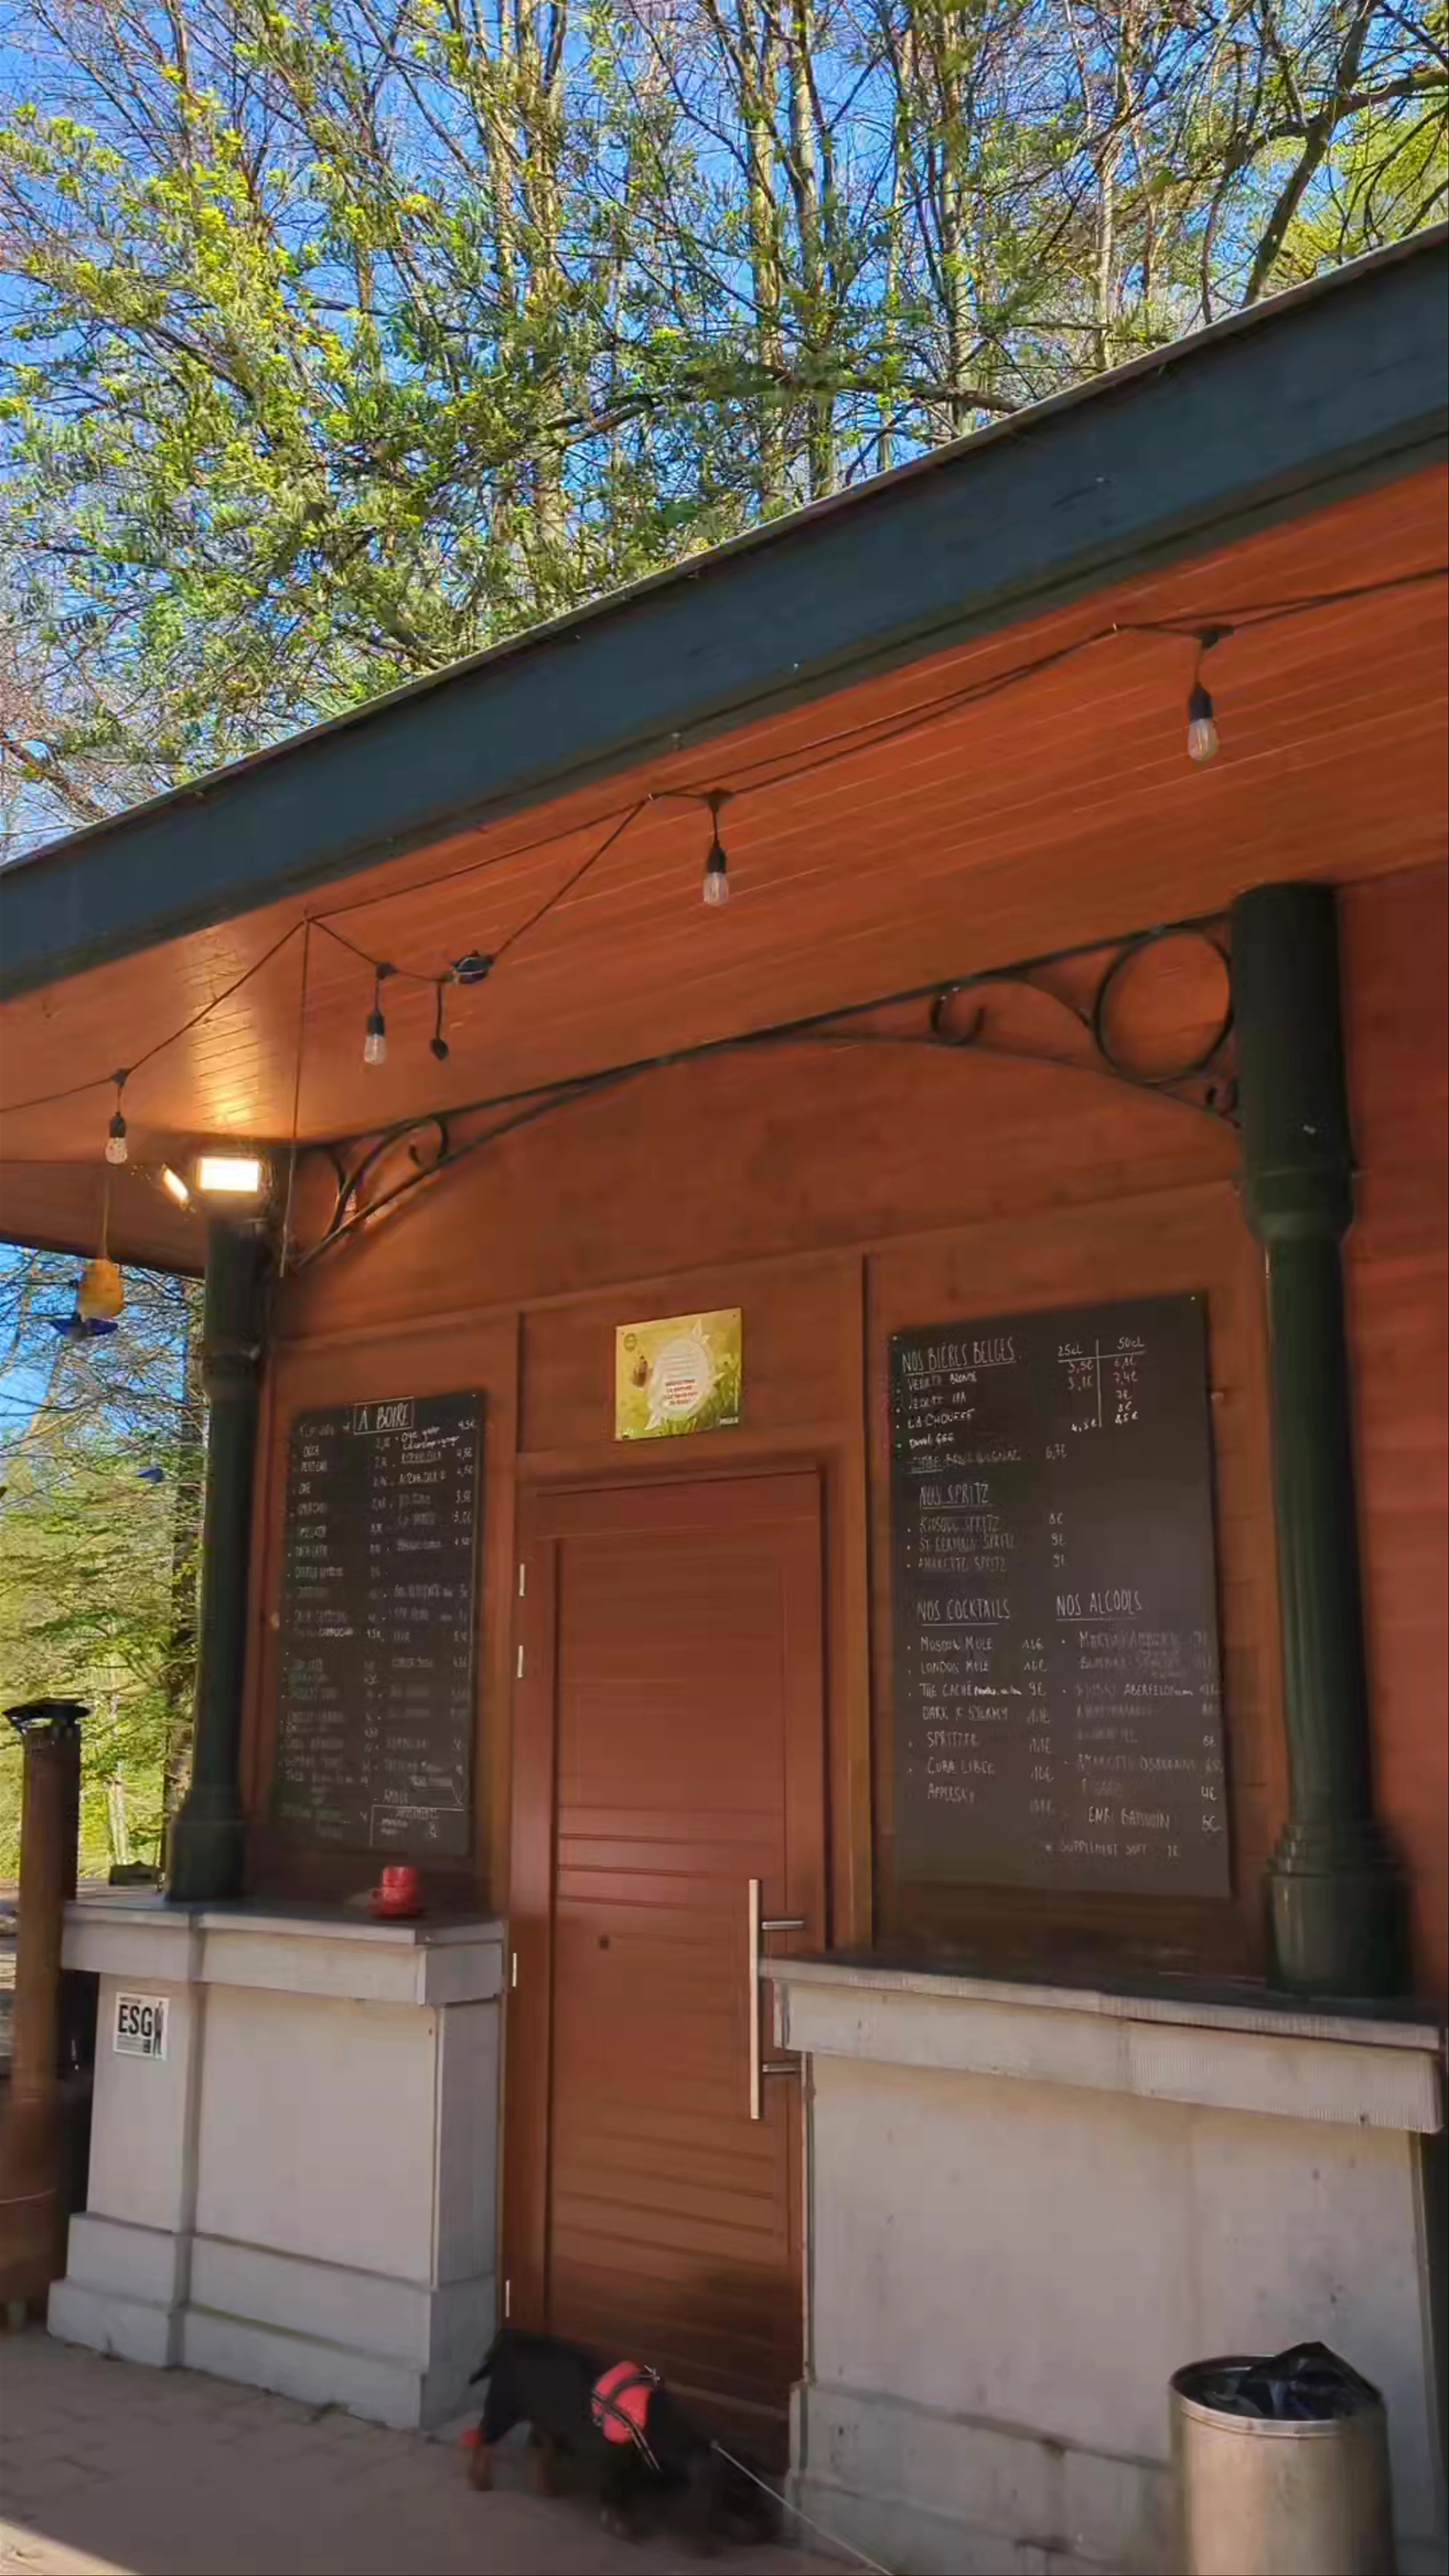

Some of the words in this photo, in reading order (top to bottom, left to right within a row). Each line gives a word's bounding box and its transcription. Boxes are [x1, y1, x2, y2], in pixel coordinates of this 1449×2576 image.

[902, 1348, 924, 1373] NOS
[377, 1402, 410, 1429] BOIRE
[948, 1481, 989, 1505] SPRITZ
[917, 1600, 941, 1621] NOS
[946, 1598, 1011, 1620] COCKTAILS
[1056, 1593, 1081, 1616] NOS
[1089, 1589, 1142, 1615] ALCOOLS
[118, 2004, 152, 2037] ESG
